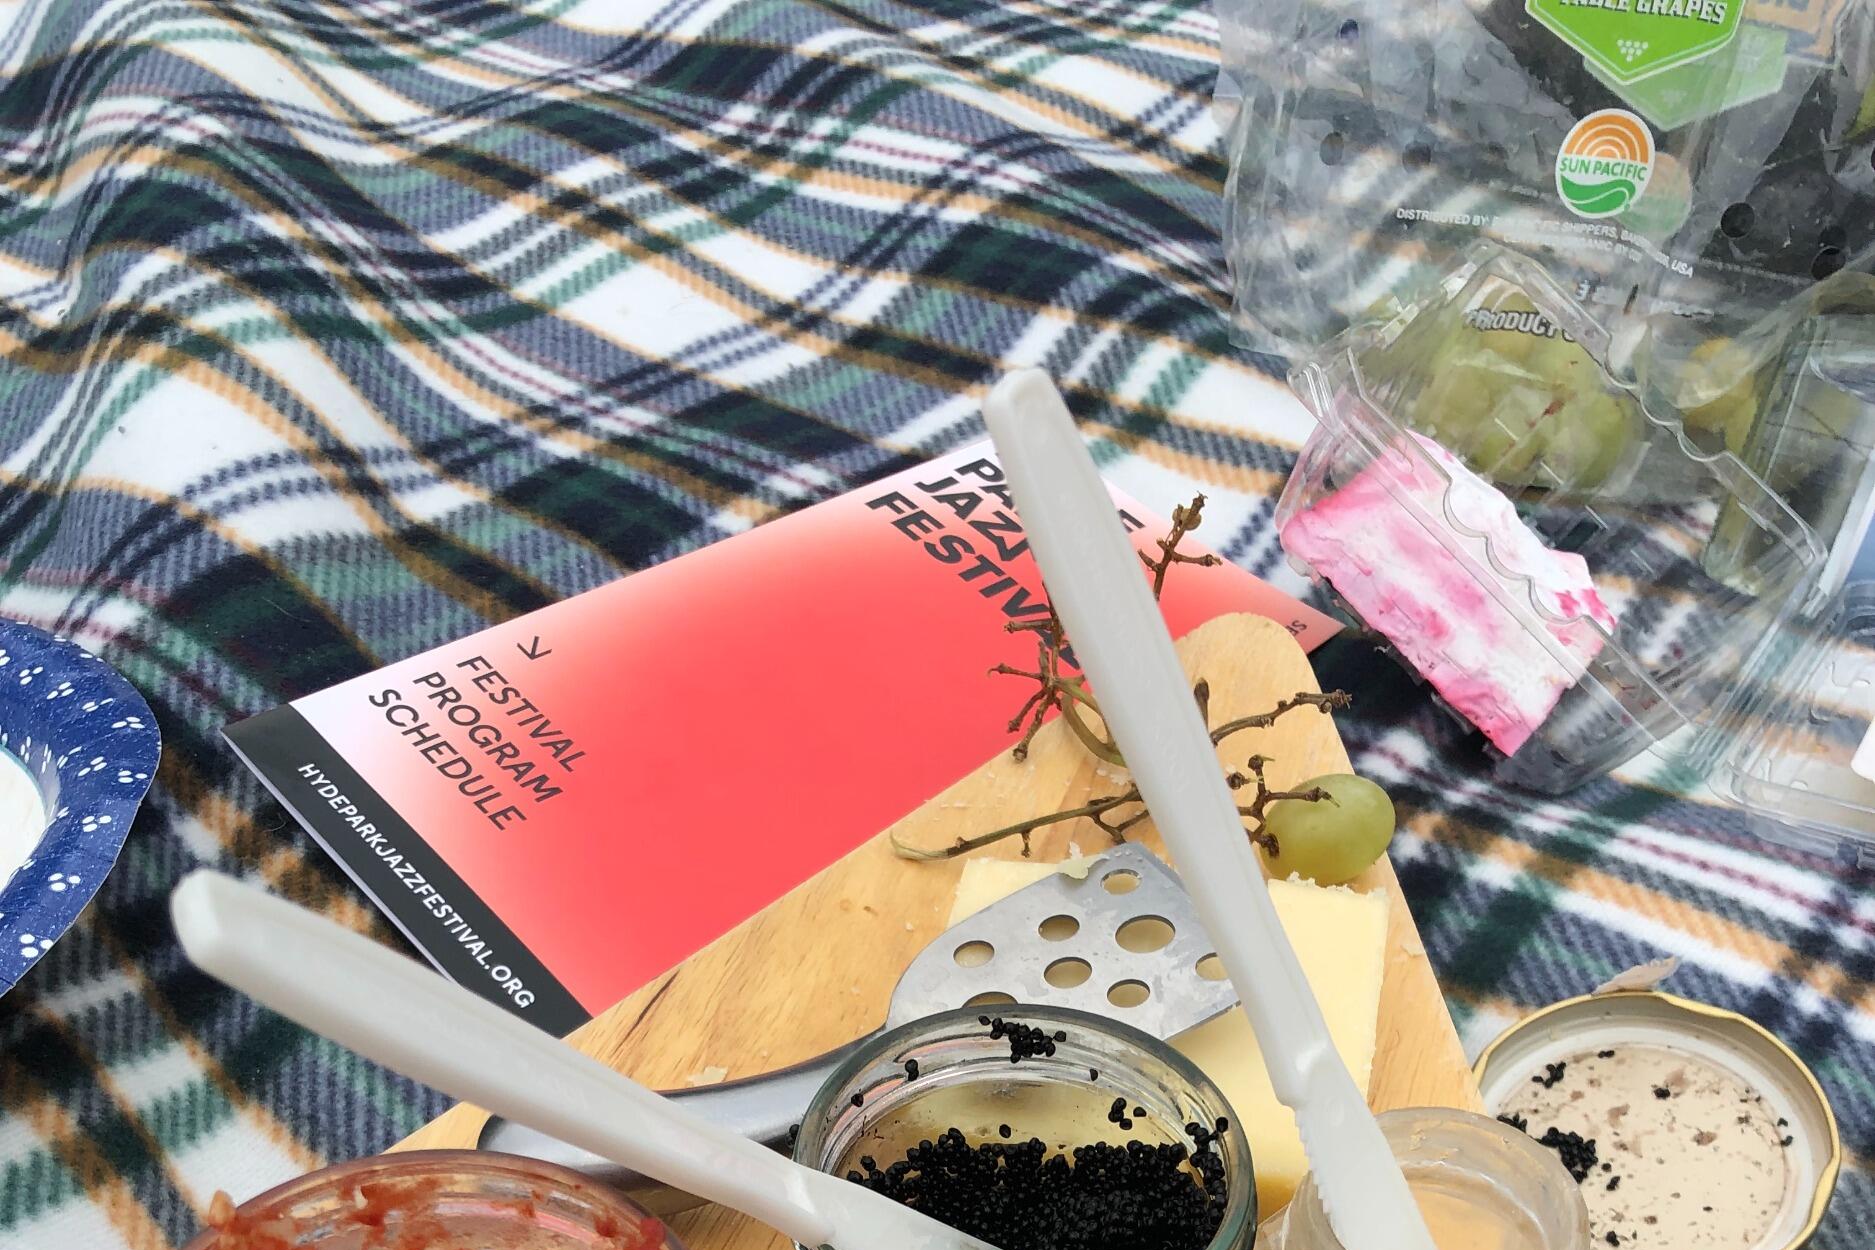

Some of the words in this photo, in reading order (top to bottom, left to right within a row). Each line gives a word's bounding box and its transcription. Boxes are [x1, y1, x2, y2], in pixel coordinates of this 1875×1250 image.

[1635, 0, 1728, 24] GRAPES
[1560, 157, 1591, 174] SUN
[1592, 160, 1648, 181] PACIFIC
[1396, 207, 1470, 226] DISTRIBUTED
[1671, 260, 1694, 278] USA
[368, 688, 527, 831] SCHEDULE
[413, 671, 563, 803] PROGRAM
[456, 655, 587, 772] FESTIVAL
[297, 762, 536, 1009] HYDEPARKJAZZFESTIVAL.ORG
